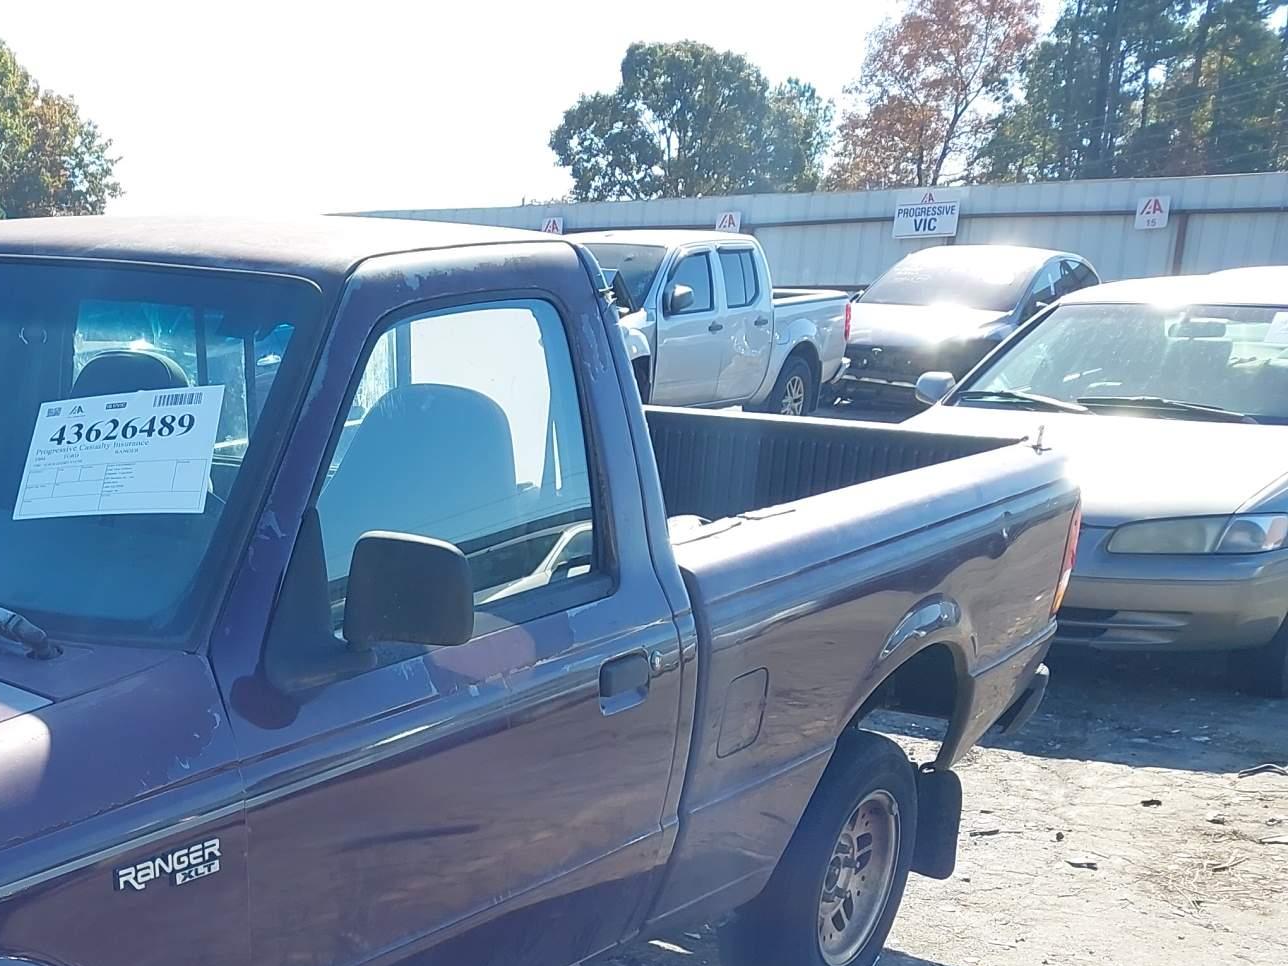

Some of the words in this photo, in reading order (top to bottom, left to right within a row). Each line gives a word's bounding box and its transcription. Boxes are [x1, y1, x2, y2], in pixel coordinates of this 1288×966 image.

[897, 204, 956, 218] PROGRESSIVE
[913, 217, 937, 232] VIC
[49, 412, 195, 446] 43626489
[36, 446, 78, 456] Progressive
[79, 443, 110, 451] Casualty
[113, 440, 149, 448] Insurance
[118, 838, 222, 890] RANGER
[179, 861, 216, 883] XLT
